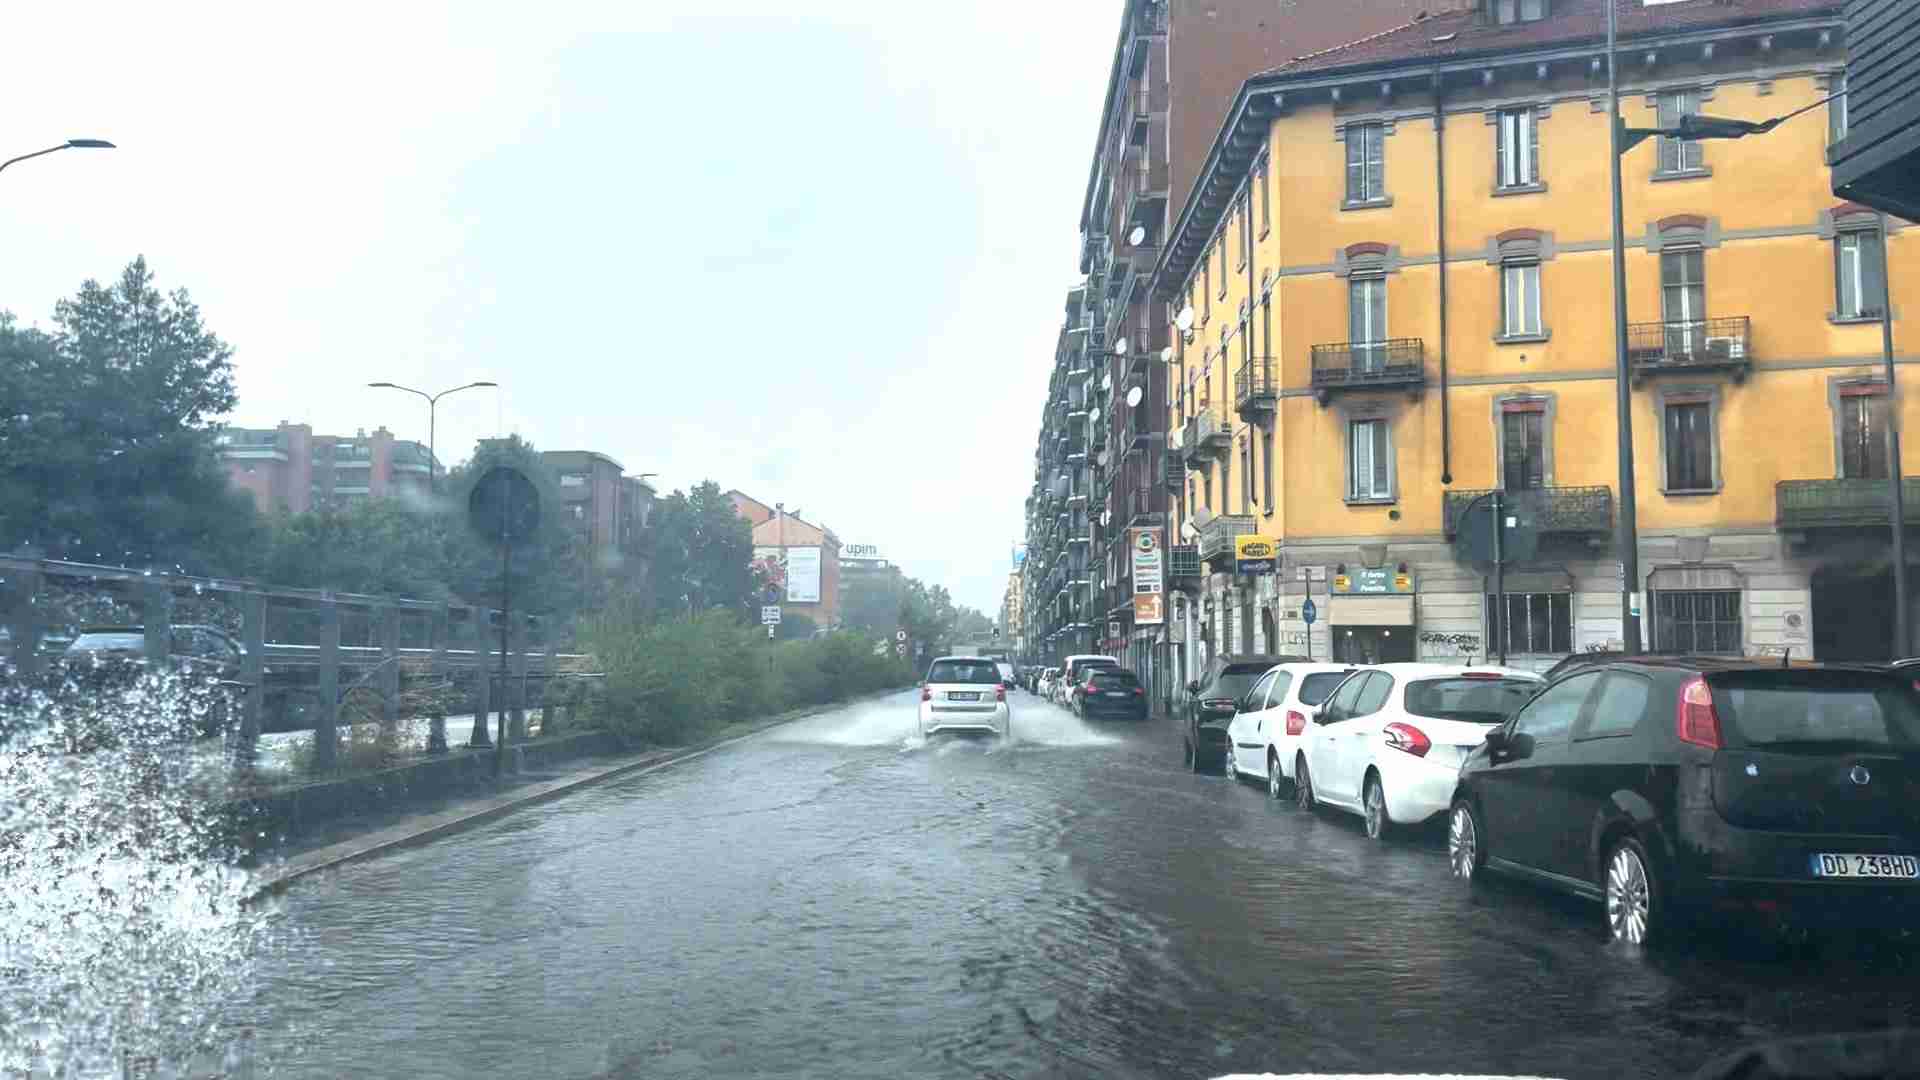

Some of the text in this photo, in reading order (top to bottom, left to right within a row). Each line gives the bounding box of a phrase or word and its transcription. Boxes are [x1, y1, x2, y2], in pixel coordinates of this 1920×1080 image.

[846, 543, 878, 556] upim
[1822, 855, 1917, 876] DD 238HD
